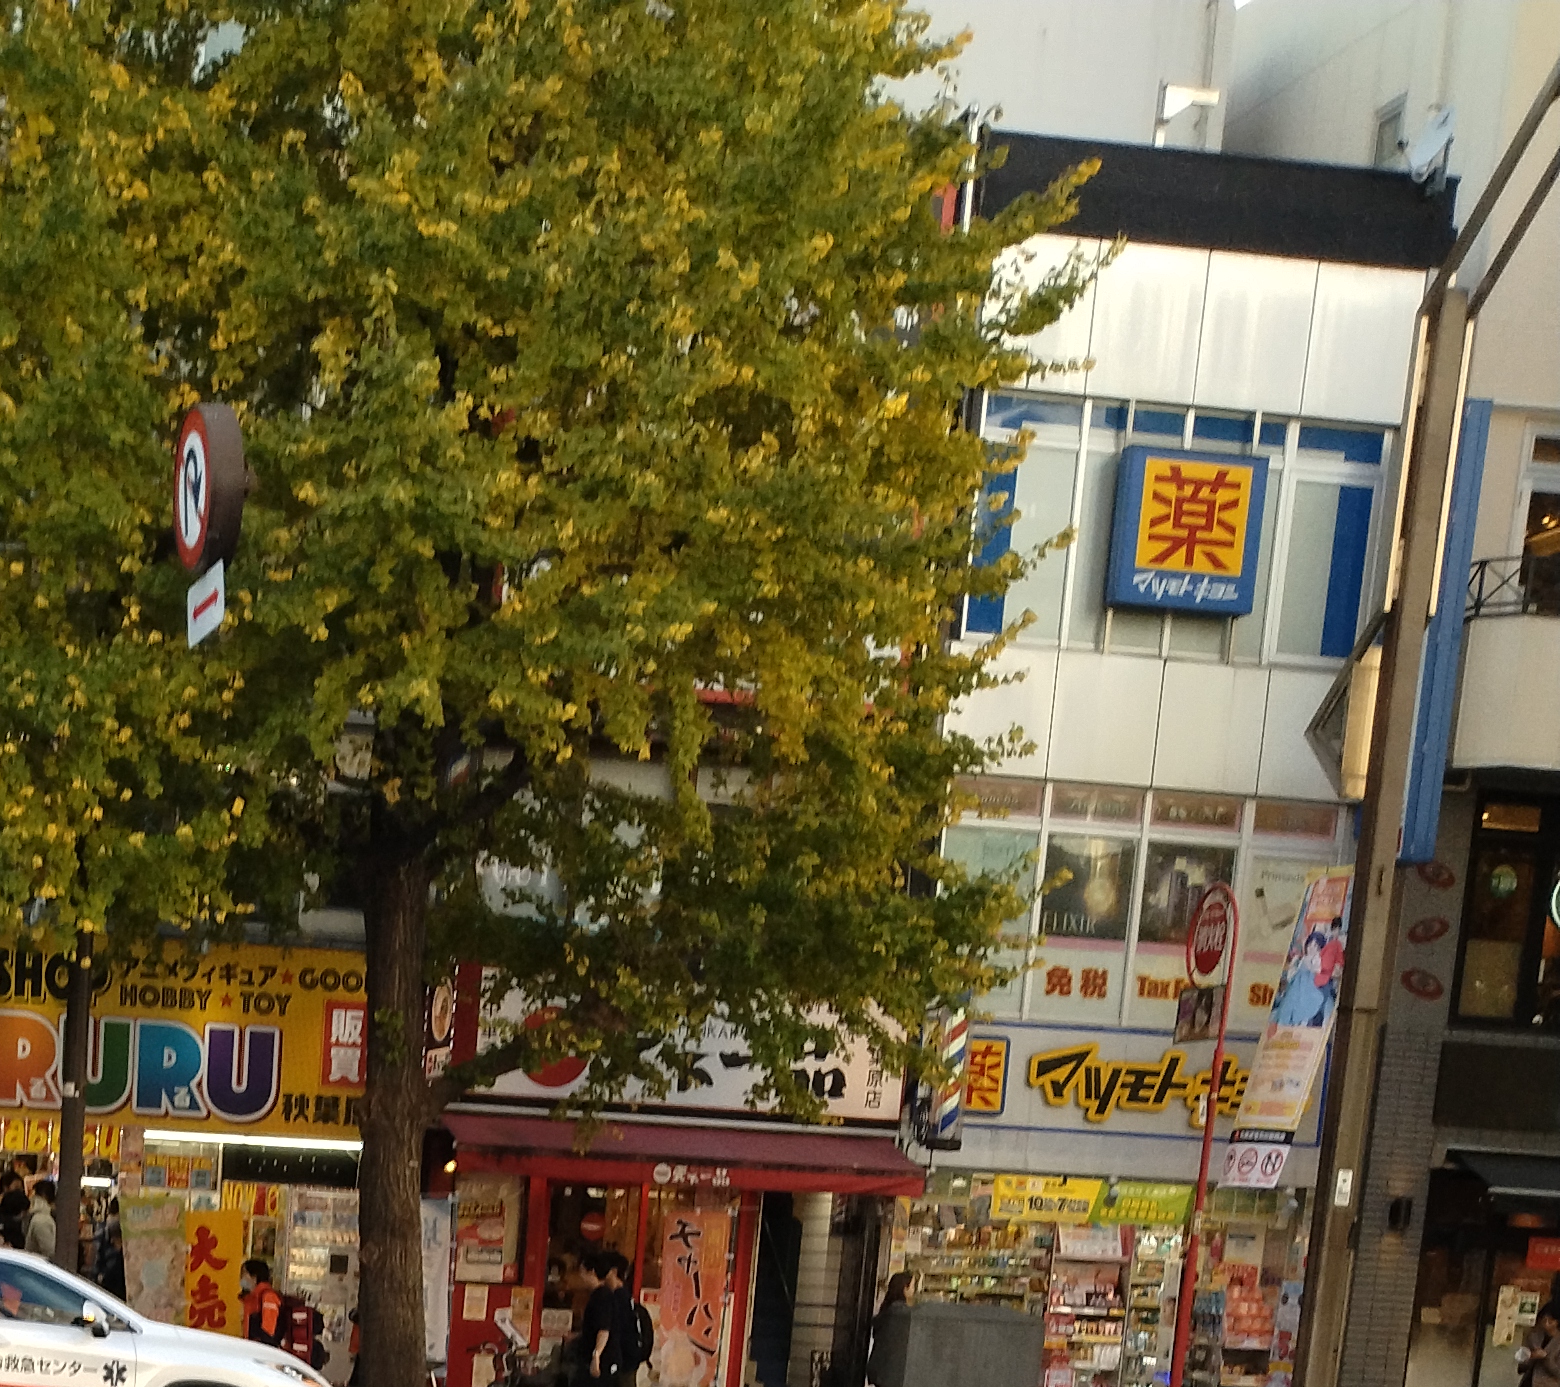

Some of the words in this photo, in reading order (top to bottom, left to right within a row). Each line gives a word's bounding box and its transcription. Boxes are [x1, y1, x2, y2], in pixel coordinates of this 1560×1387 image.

[1148, 465, 1242, 571] 薬
[298, 967, 366, 993] GOO
[1045, 965, 1108, 999] 免税
[120, 984, 212, 1010] HOBBY
[240, 991, 292, 1016] TOY
